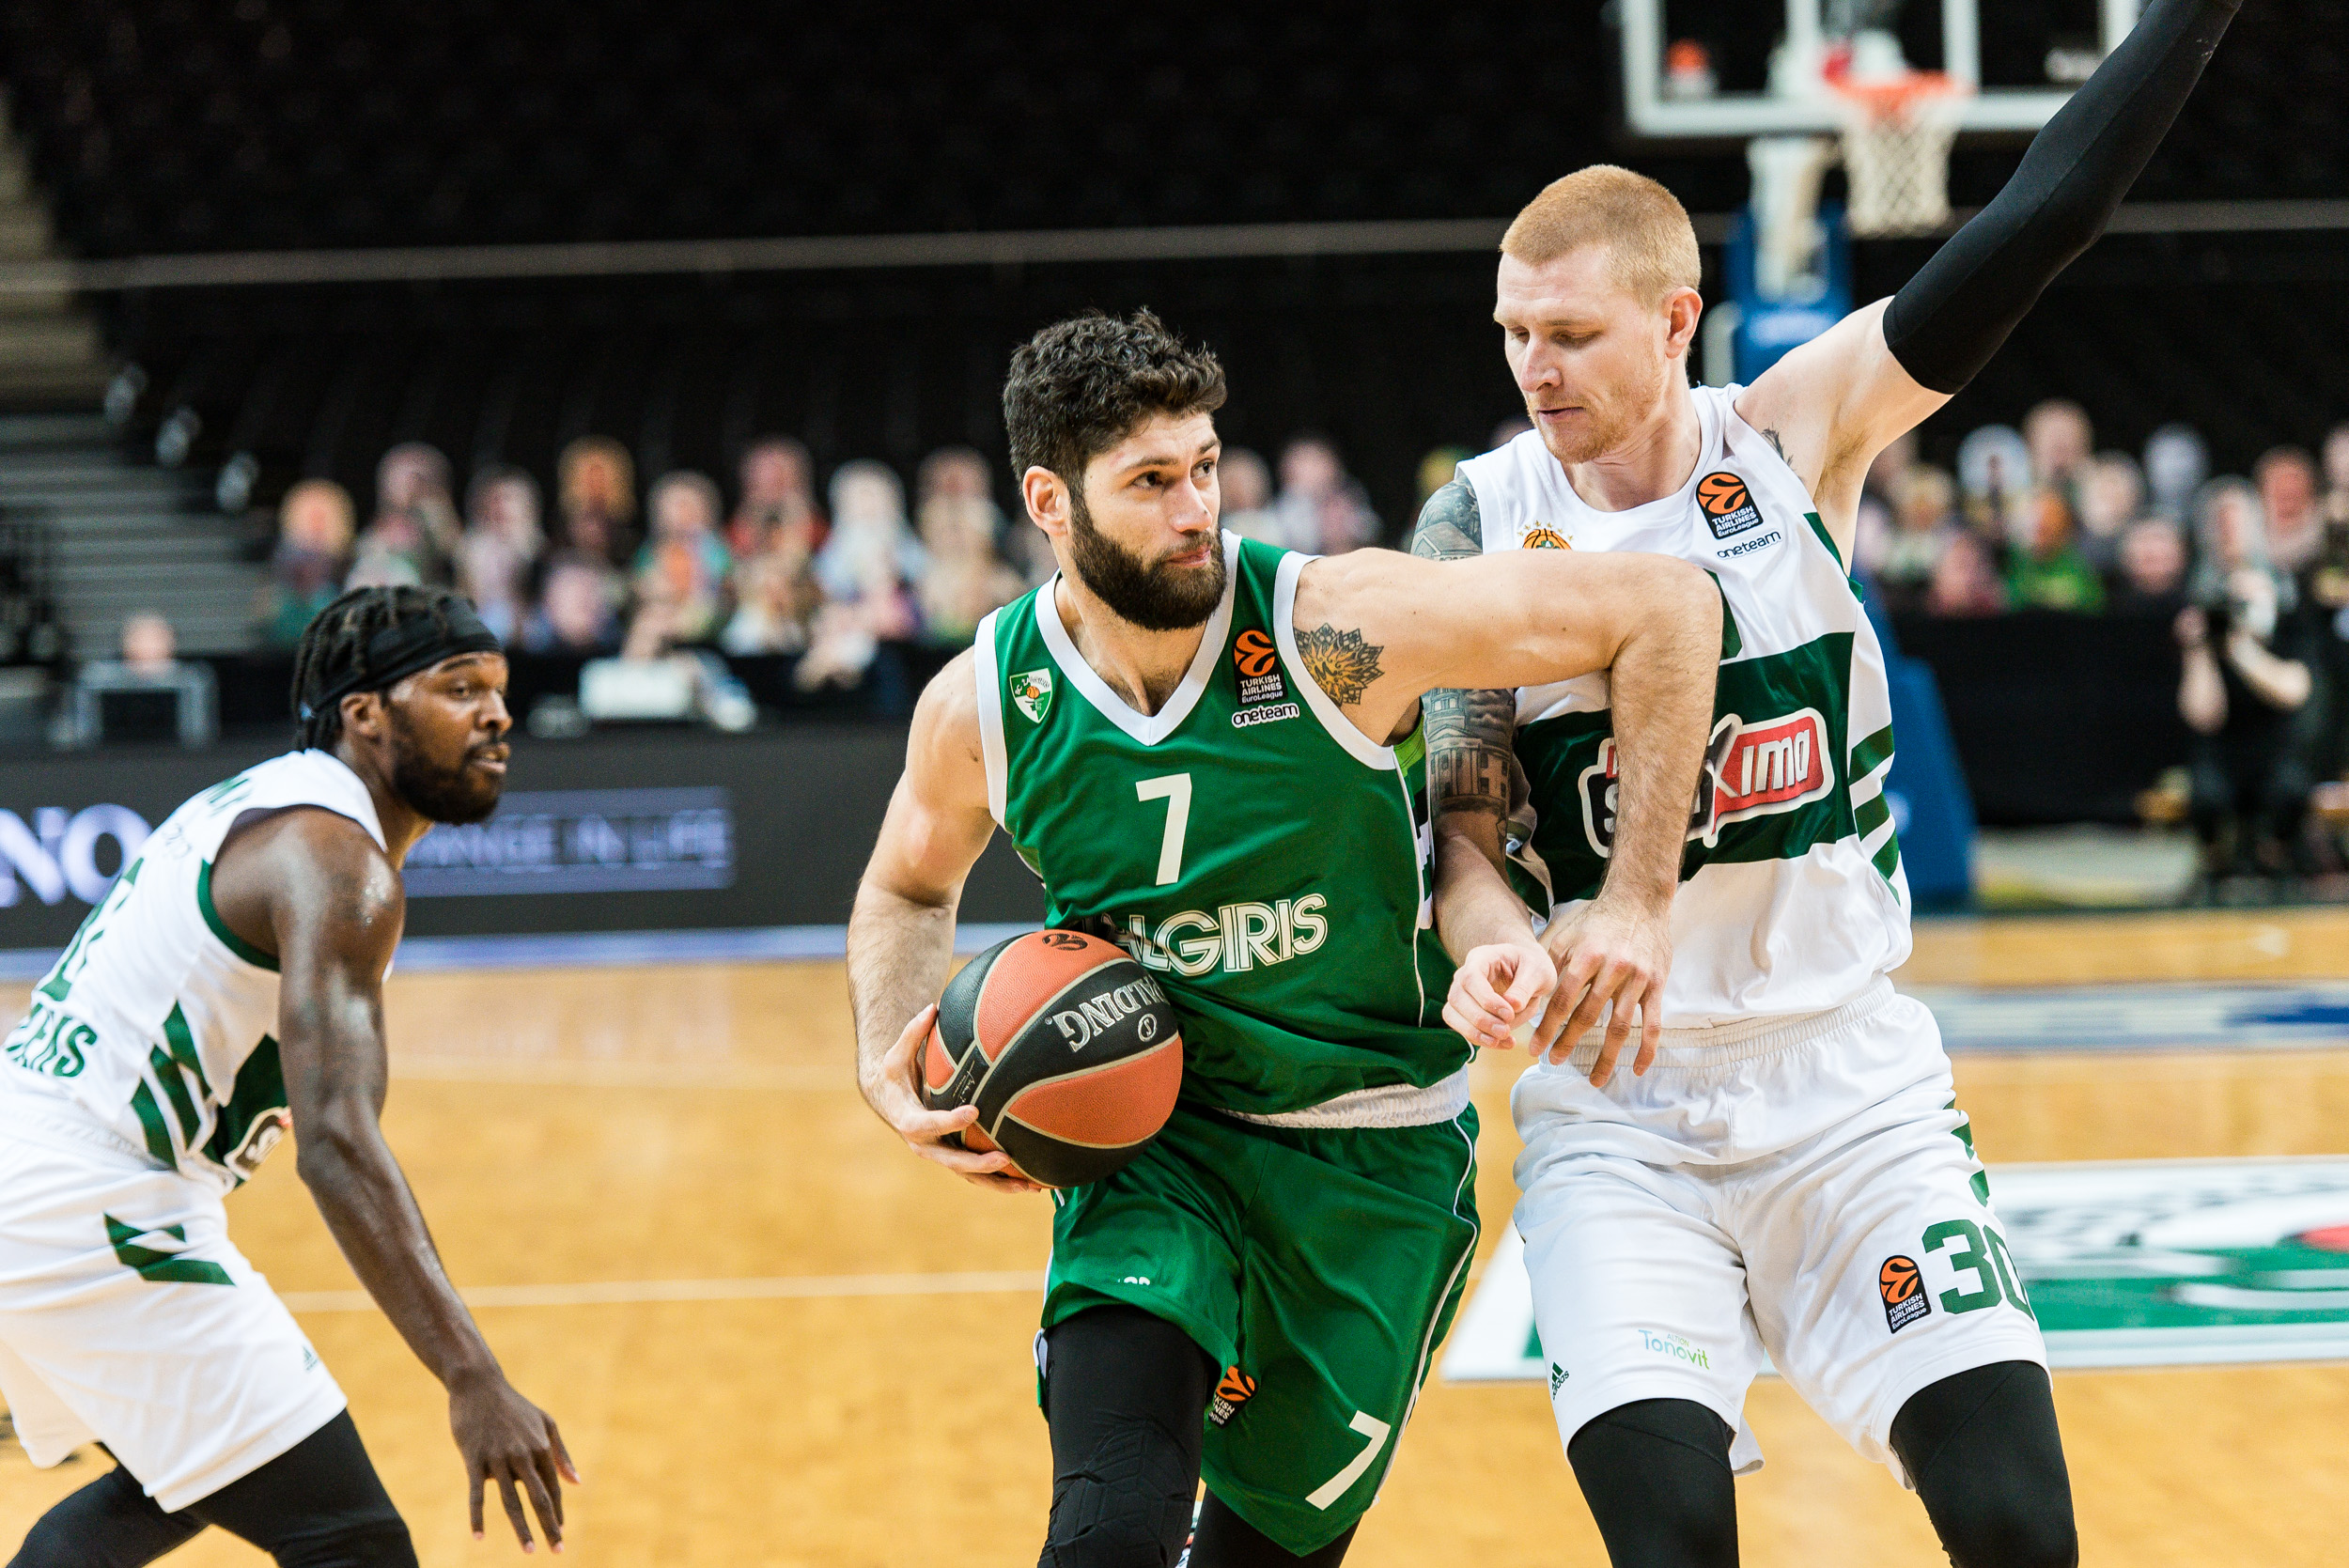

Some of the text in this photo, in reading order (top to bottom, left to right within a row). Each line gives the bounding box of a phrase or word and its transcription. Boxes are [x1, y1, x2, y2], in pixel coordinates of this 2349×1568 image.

[1712, 505, 1754, 526] TURKISH
[1716, 512, 1757, 532] AIRLINES
[1717, 518, 1760, 537] EuroLeague
[1717, 531, 1781, 559] oneteam
[1240, 674, 1281, 689] TURKISH
[1241, 682, 1283, 696] AIRLINES
[1241, 691, 1283, 704] EuroLeague
[1233, 705, 1299, 725] oneteam
[1135, 773, 1191, 886] 7
[1052, 973, 1171, 1053] PALDING
[1921, 1219, 2035, 1323] 30
[1889, 1293, 1923, 1316] TURKISH
[1890, 1299, 1925, 1324] AIRLINES
[1891, 1307, 1927, 1330] EuroLeague
[1638, 1329, 1710, 1370] Tonovit
[1667, 1333, 1689, 1347] ALTION
[1306, 1410, 1391, 1511] 7
